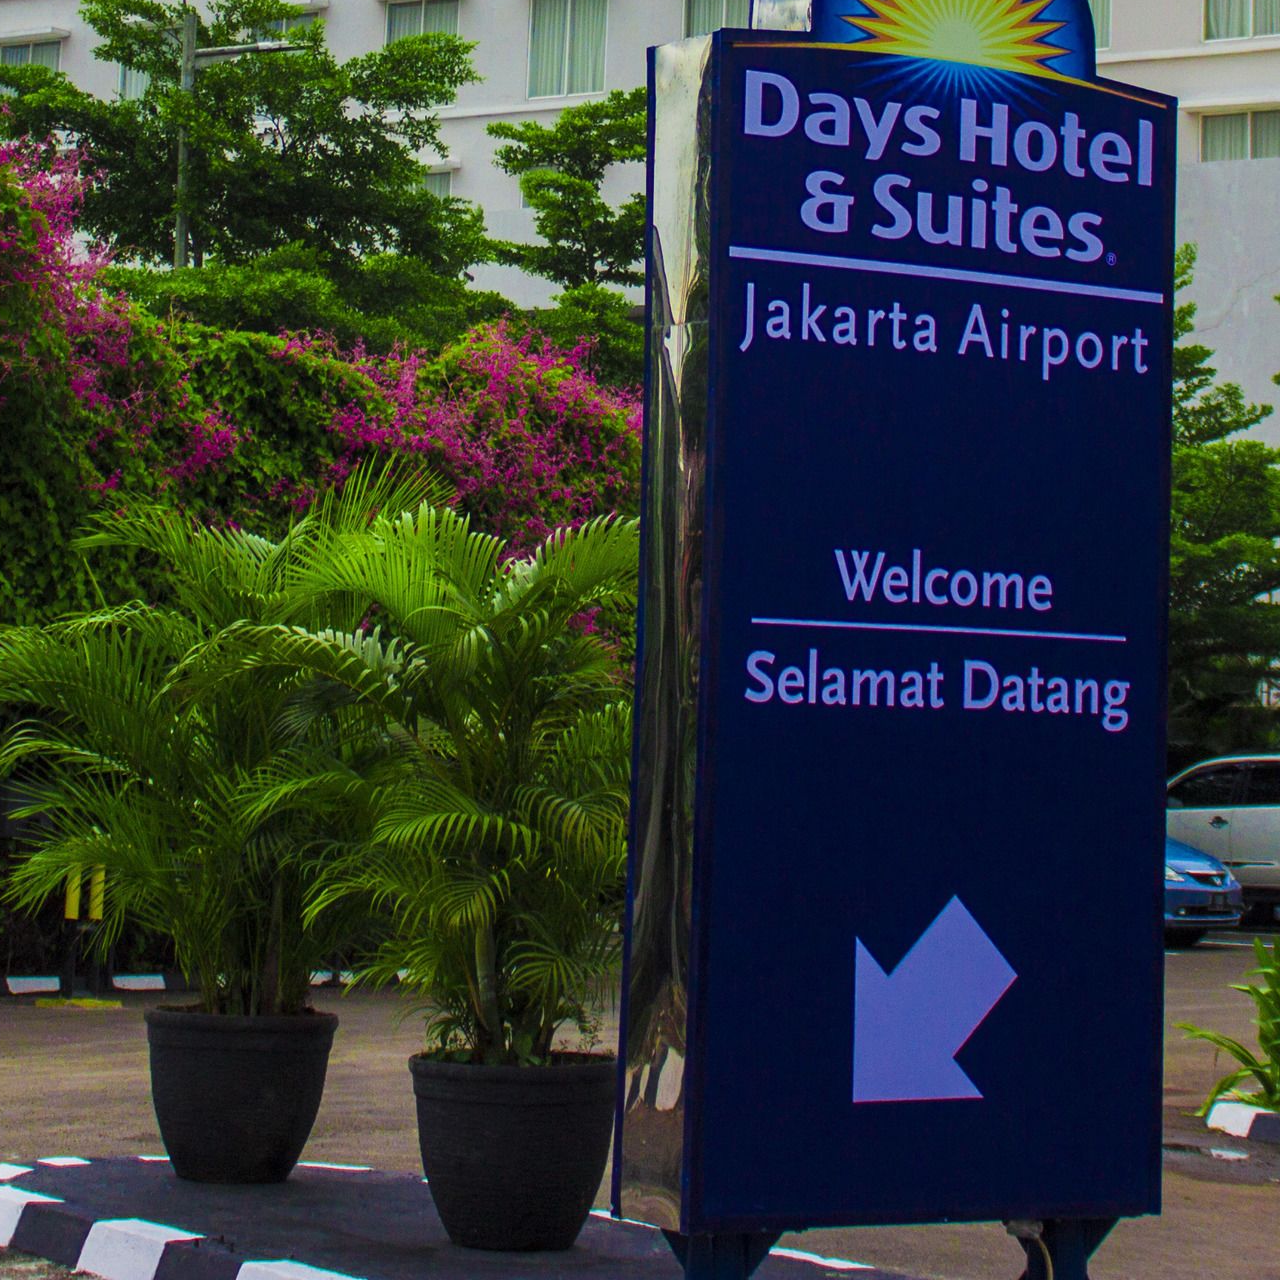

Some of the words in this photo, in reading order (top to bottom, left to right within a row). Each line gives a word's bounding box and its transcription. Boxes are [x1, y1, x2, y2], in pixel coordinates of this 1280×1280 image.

[744, 69, 941, 161] Days
[959, 98, 1153, 187] Hotel
[800, 170, 855, 234] &
[739, 282, 938, 353] Jakarta
[957, 303, 1149, 381] Airport
[834, 549, 1053, 611] Welcome
[744, 648, 944, 708] Selamat
[963, 659, 1130, 732] Datang
